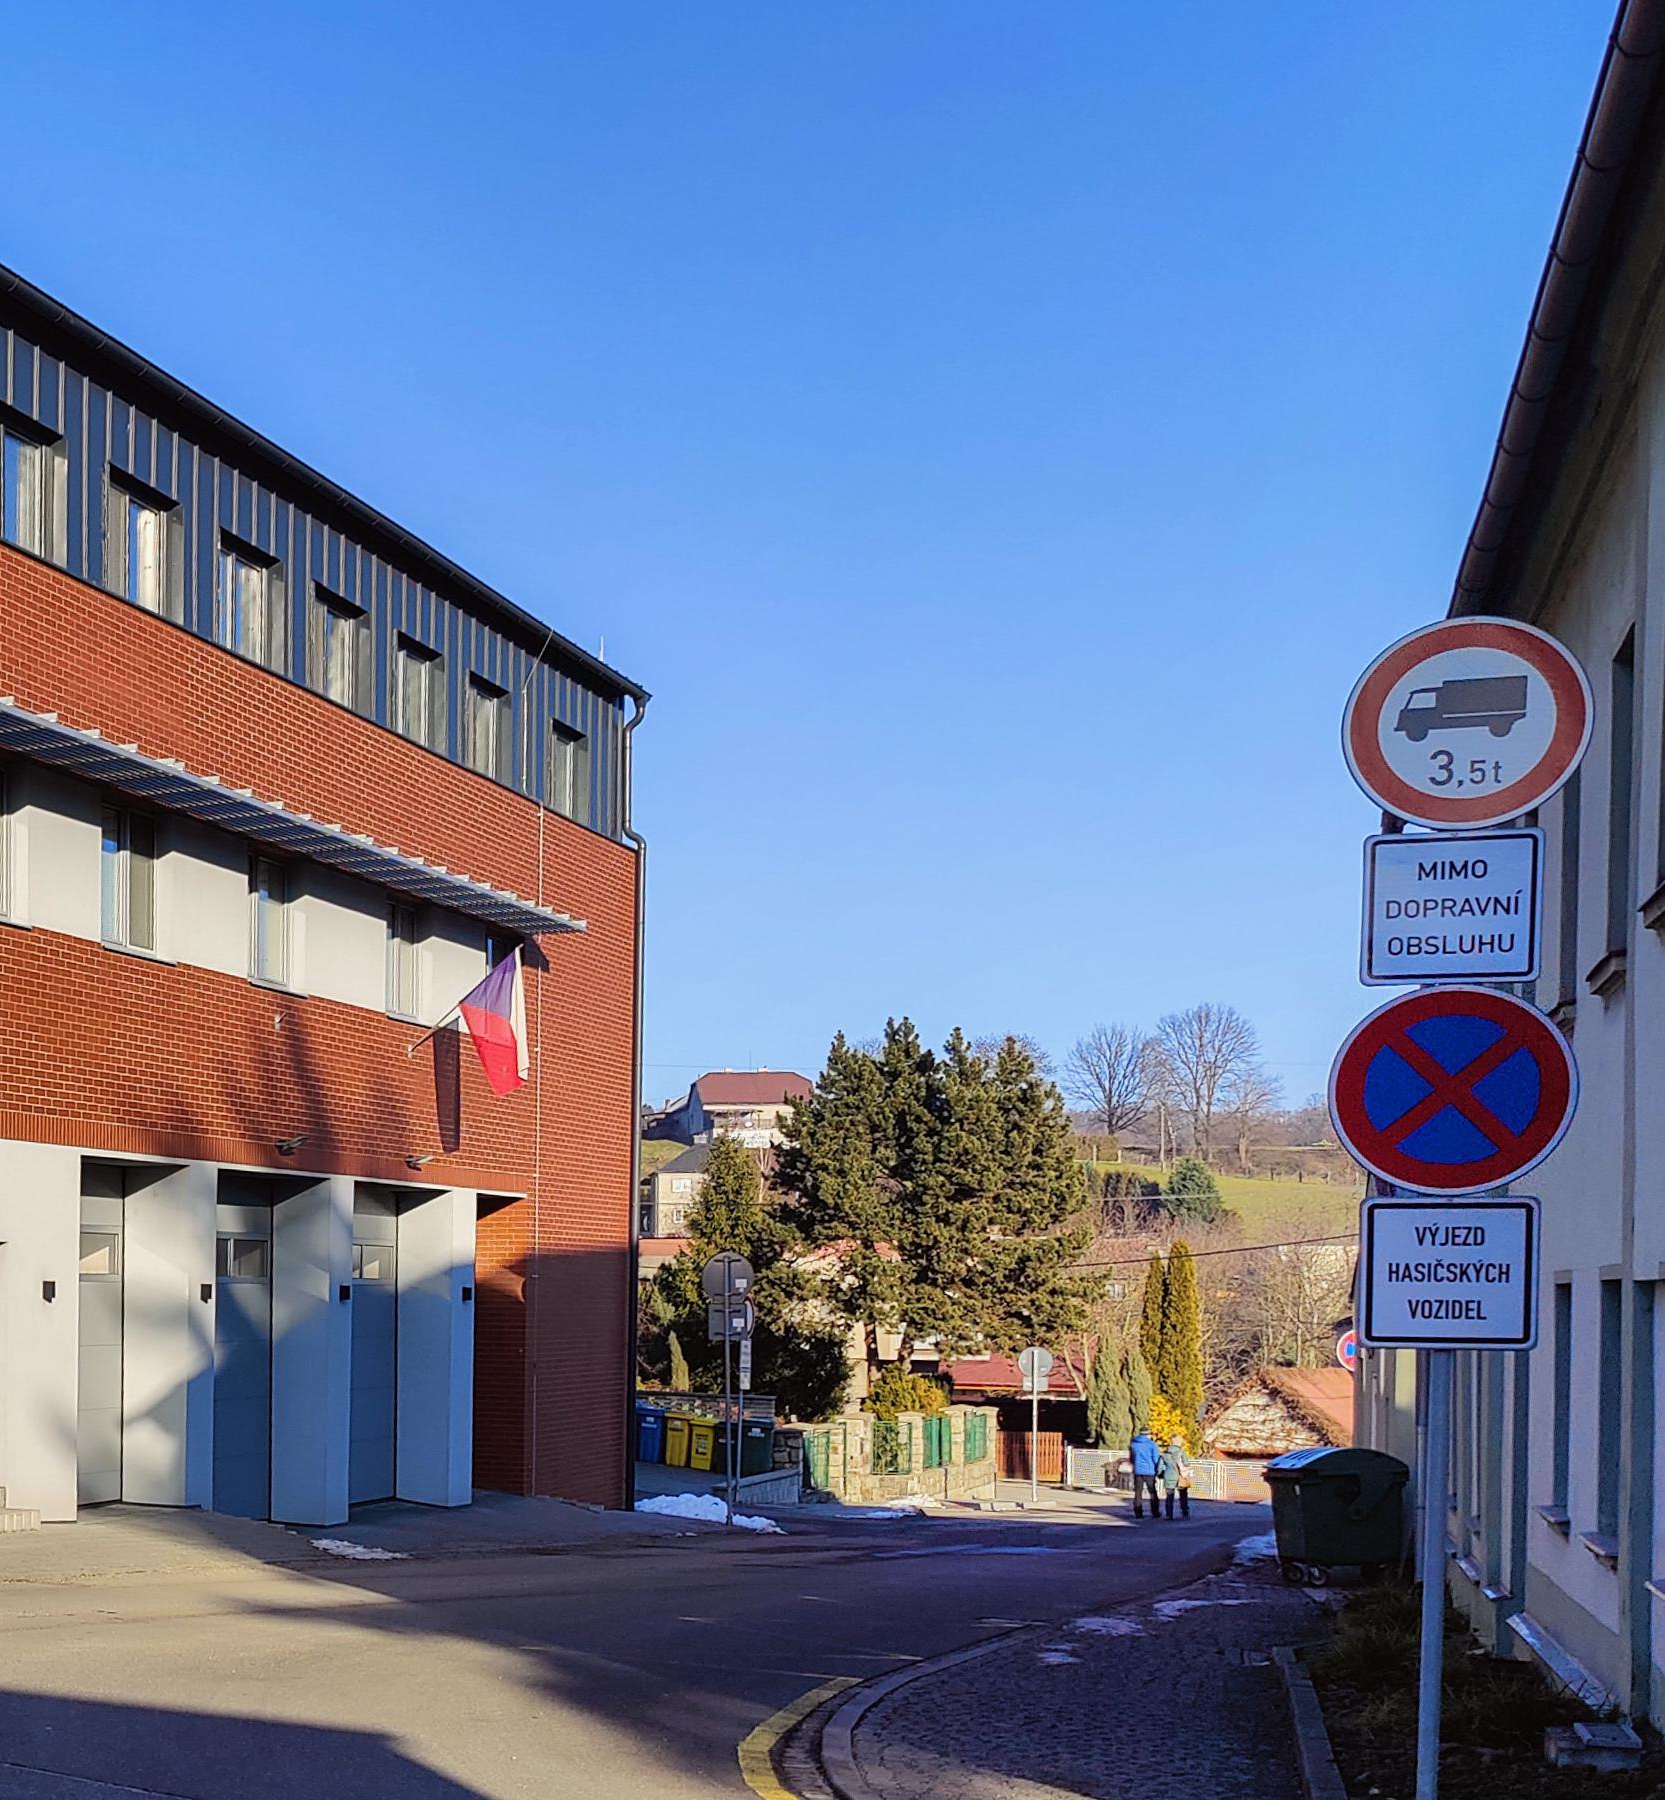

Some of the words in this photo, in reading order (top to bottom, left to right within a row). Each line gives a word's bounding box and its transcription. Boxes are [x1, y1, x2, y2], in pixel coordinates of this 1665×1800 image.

[1417, 859, 1489, 881] MIMO
[1385, 889, 1523, 919] DOPRAVNÍ
[1387, 933, 1515, 956] OBSLUHU
[1414, 1222, 1486, 1247] VÝJEZD
[1388, 1258, 1511, 1284] HASIČSKÝCH
[1407, 1299, 1488, 1321] VOZIDEL
